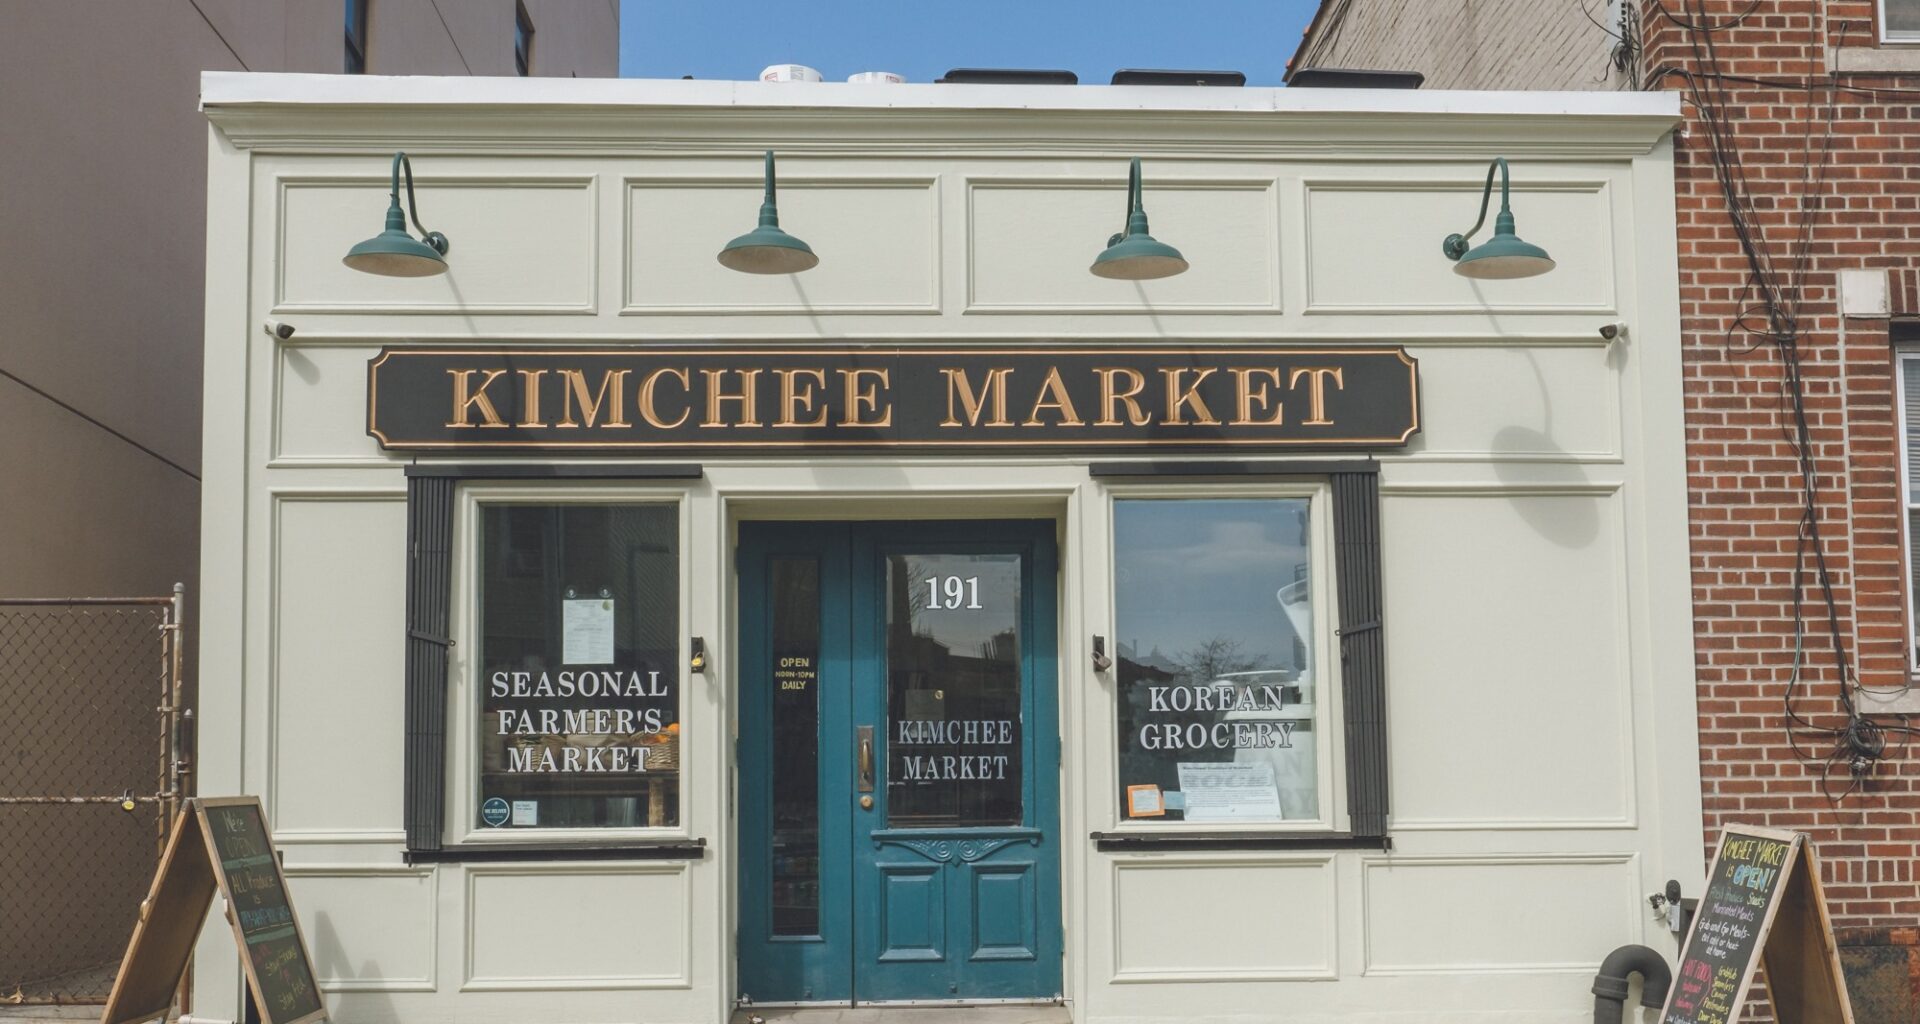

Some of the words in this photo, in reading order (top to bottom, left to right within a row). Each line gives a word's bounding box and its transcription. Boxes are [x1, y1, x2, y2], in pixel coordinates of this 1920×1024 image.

[445, 366, 893, 429] KIMCHEE
[939, 366, 1345, 428] MARKET
[925, 575, 983, 610] 191
[780, 657, 810, 668] OPEN
[491, 671, 668, 698] SEASONAL
[781, 680, 807, 690] DAILY
[1148, 685, 1284, 712] KOREAN
[497, 708, 662, 735] FARMER'S
[897, 720, 1013, 745] KIMCHEE
[1139, 721, 1296, 750] GROCERY
[507, 747, 651, 773] MARKET
[902, 755, 1009, 780] MARKET
[1721, 836, 1757, 861] KIMCHEE
[1751, 839, 1791, 867] MARKET
[1733, 864, 1777, 893] OPEN!
